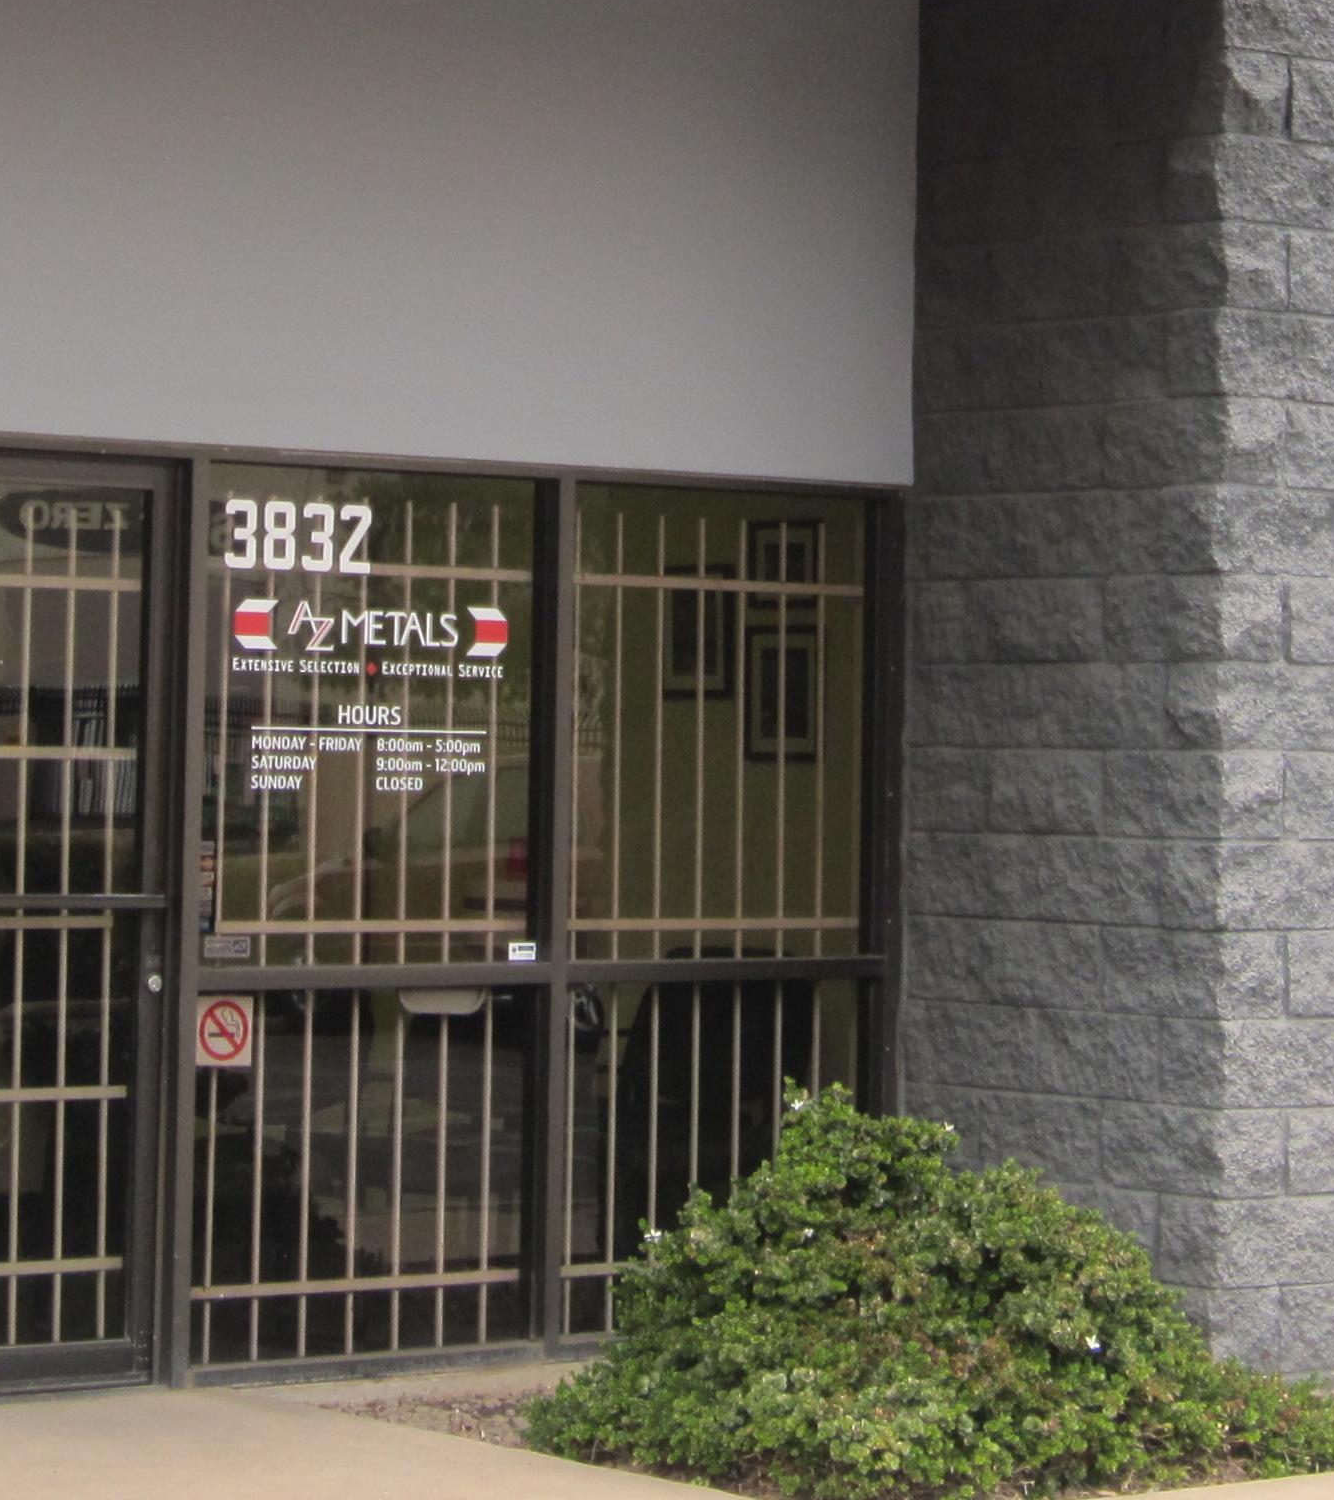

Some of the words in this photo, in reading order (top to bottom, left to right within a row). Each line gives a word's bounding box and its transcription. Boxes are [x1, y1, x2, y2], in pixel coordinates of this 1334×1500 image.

[223, 498, 372, 575] 3832
[287, 600, 335, 651] AZ
[341, 609, 459, 648] METALS
[232, 657, 294, 673] EXTENSIVE
[299, 660, 360, 675] SELECTION
[382, 661, 453, 677] EXCEPTIONAL
[458, 663, 504, 679] SERVICE
[338, 705, 402, 726] HOURS
[251, 736, 307, 750] MONDAY
[319, 737, 363, 751] FRIDAY
[377, 738, 423, 752] 8:00am
[435, 740, 481, 755] 5:00pm
[251, 756, 317, 770] SATURDAY
[435, 758, 486, 775] 12:00pm
[251, 775, 303, 790] SUNDAY
[376, 777, 423, 791] CLOSED
